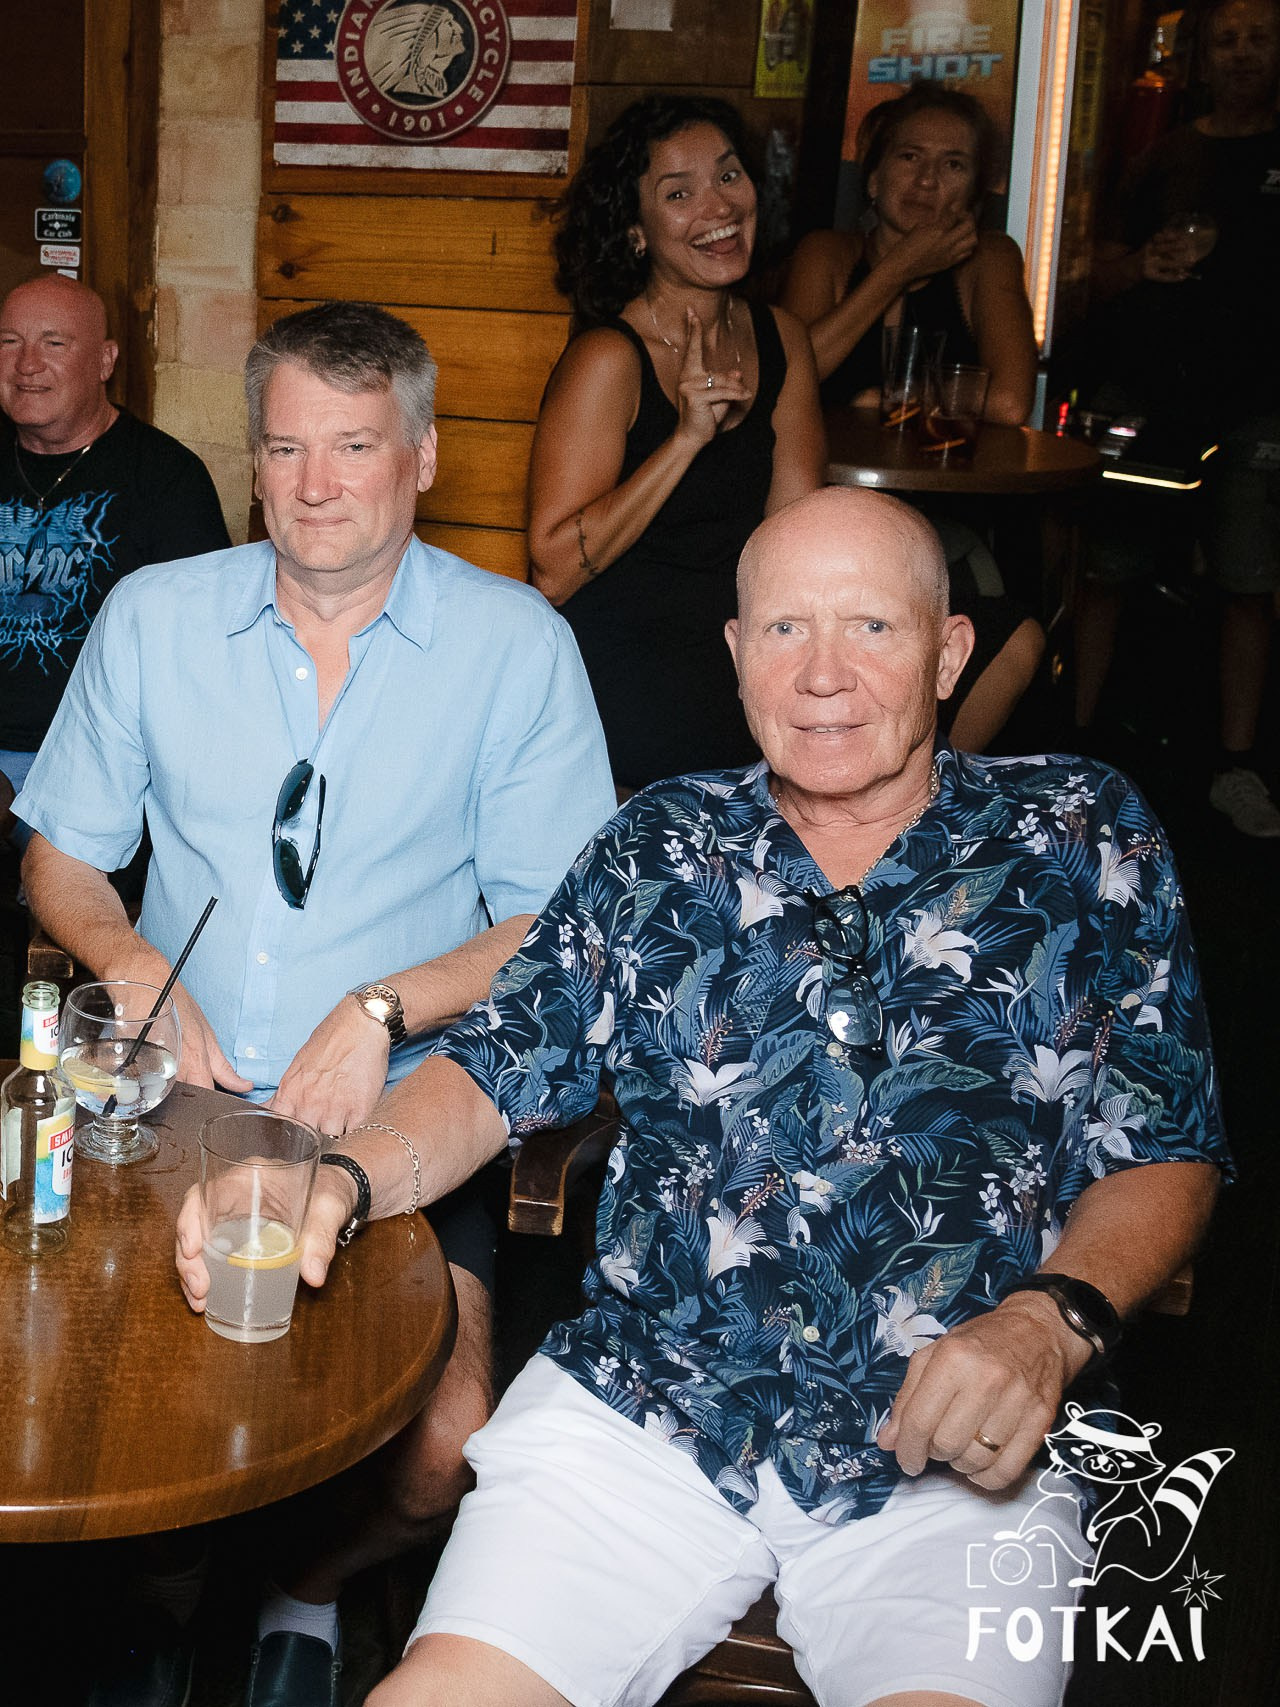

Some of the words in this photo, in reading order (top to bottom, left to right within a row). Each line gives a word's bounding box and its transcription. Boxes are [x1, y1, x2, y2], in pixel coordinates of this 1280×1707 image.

[882, 25, 992, 53] FIRE
[867, 52, 1004, 83] SHOT
[388, 112, 446, 132] 1901
